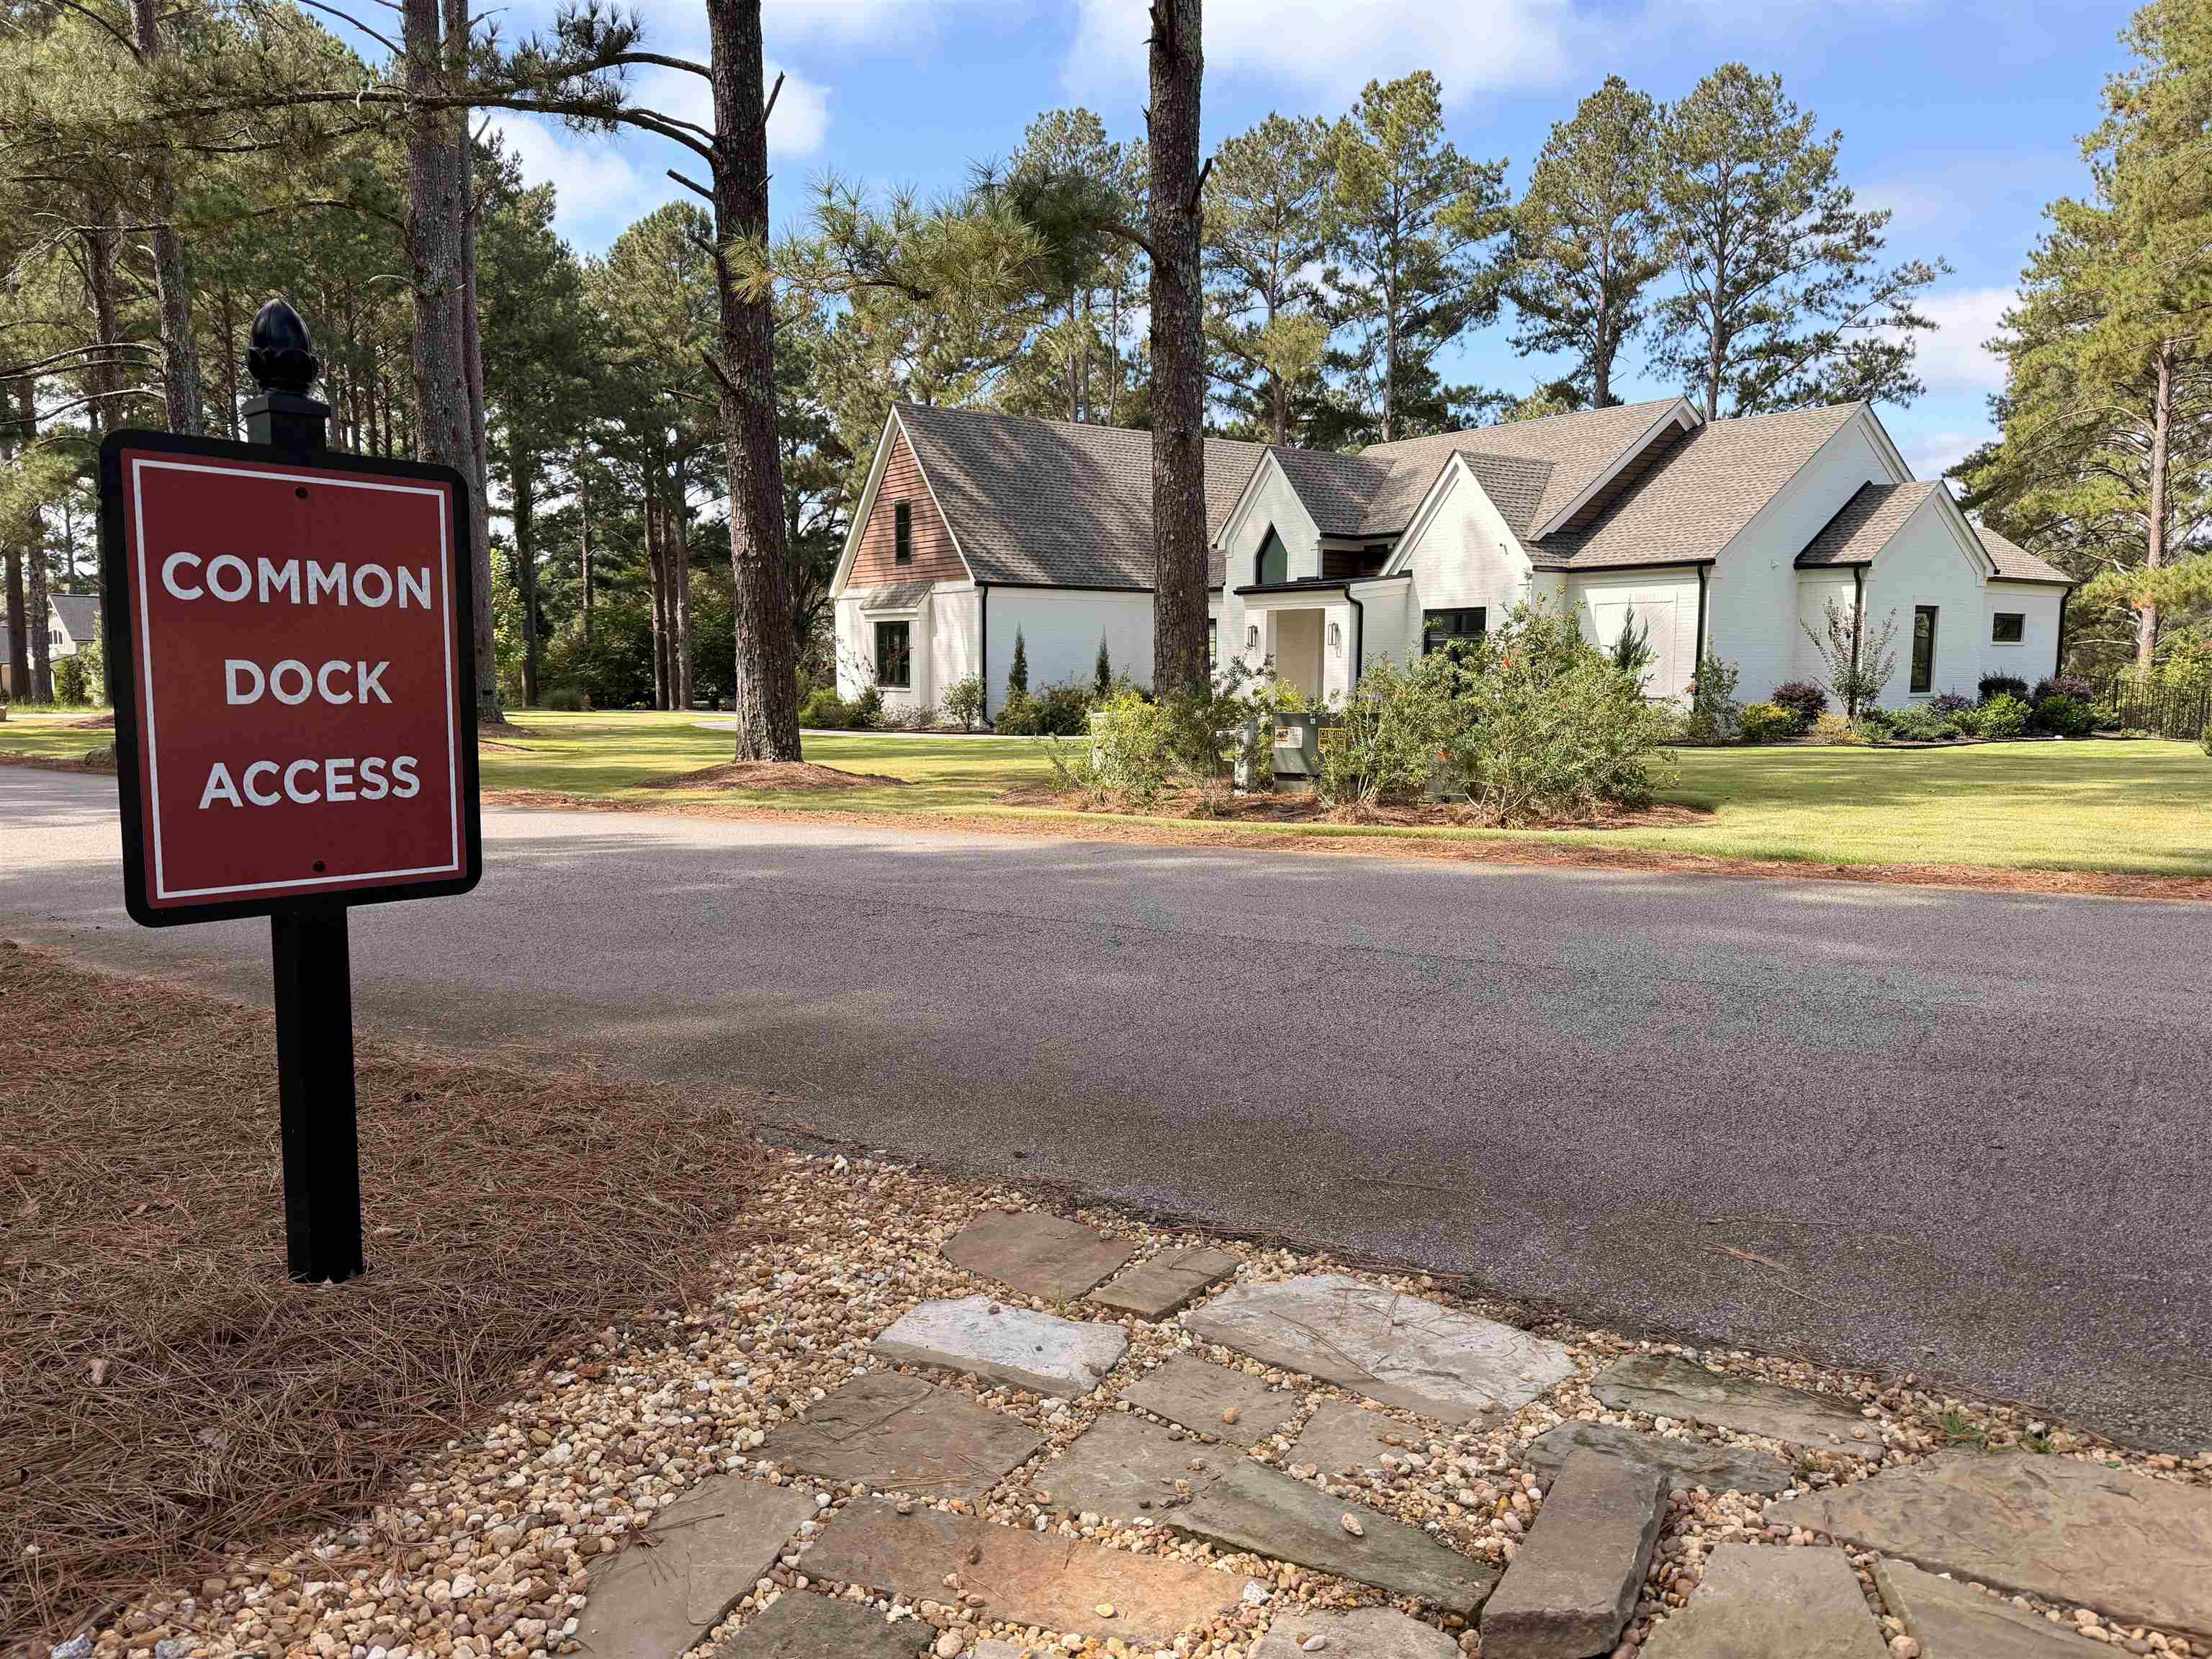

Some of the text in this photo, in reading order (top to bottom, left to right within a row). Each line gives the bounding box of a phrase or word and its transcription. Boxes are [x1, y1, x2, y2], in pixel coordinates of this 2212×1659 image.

[162, 552, 432, 609] COMMON
[225, 659, 393, 705] DOCK
[199, 755, 421, 809] ACCESS
